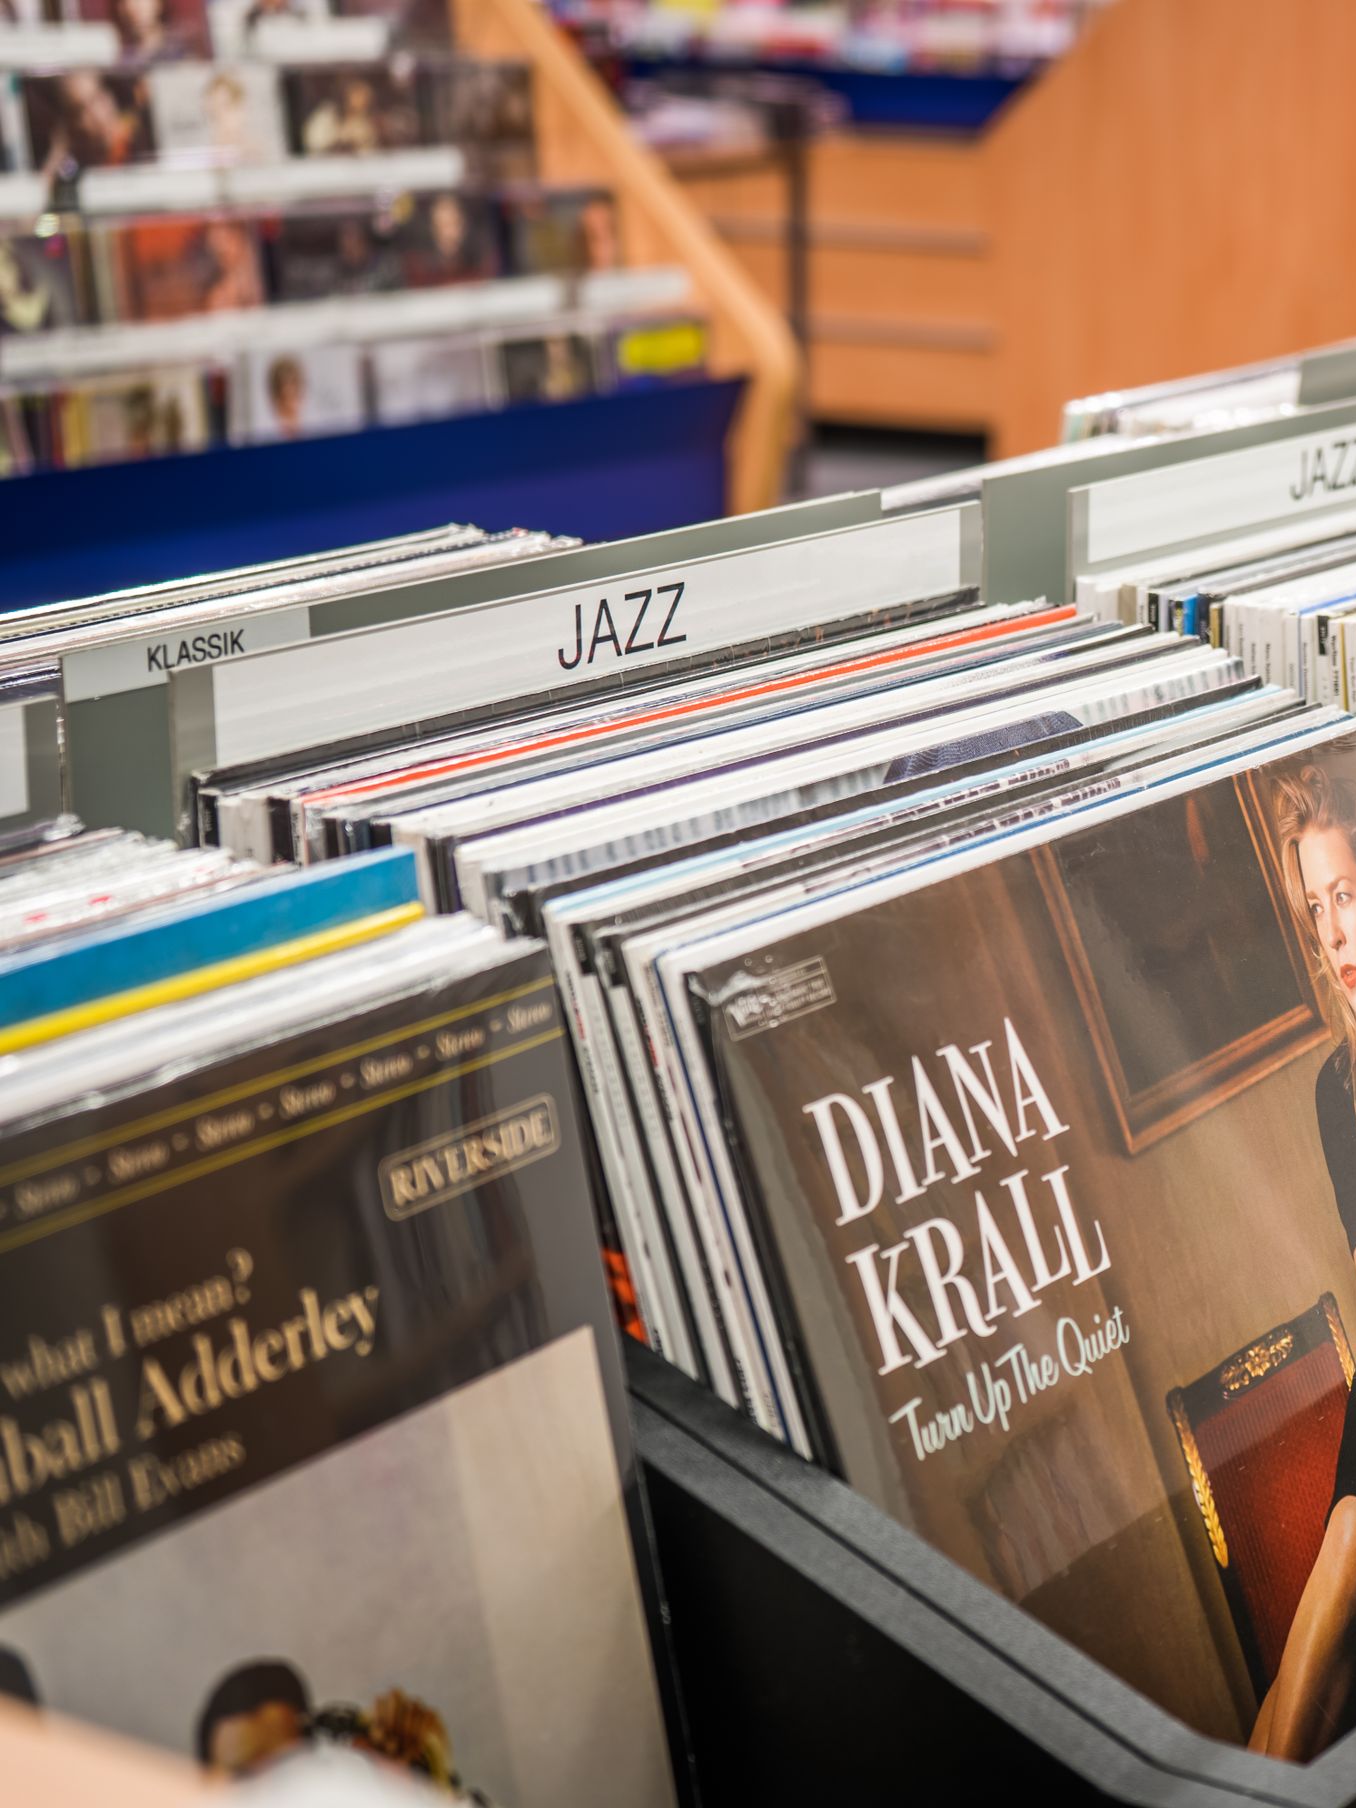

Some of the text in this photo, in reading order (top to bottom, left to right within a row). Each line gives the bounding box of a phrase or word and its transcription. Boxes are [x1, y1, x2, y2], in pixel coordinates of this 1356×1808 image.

[147, 629, 245, 672] KLASSIK
[558, 582, 687, 670] JAZZ
[195, 1110, 256, 1151] Stereo
[278, 1080, 337, 1121] Stereo
[359, 1053, 415, 1091] Stereo
[435, 1026, 487, 1062] Stereo
[506, 1001, 551, 1035] Stereo
[802, 1016, 1070, 1227] DIANA
[388, 1109, 553, 1206] RIVERSIDE
[1, 1247, 255, 1399] what I mean?
[845, 1164, 1112, 1377] KRALL
[135, 1285, 380, 1441] Adderley
[889, 1305, 1131, 1461] Turn Up The Quiet
[53, 1468, 127, 1548] Bill
[127, 1432, 248, 1513] Evans
